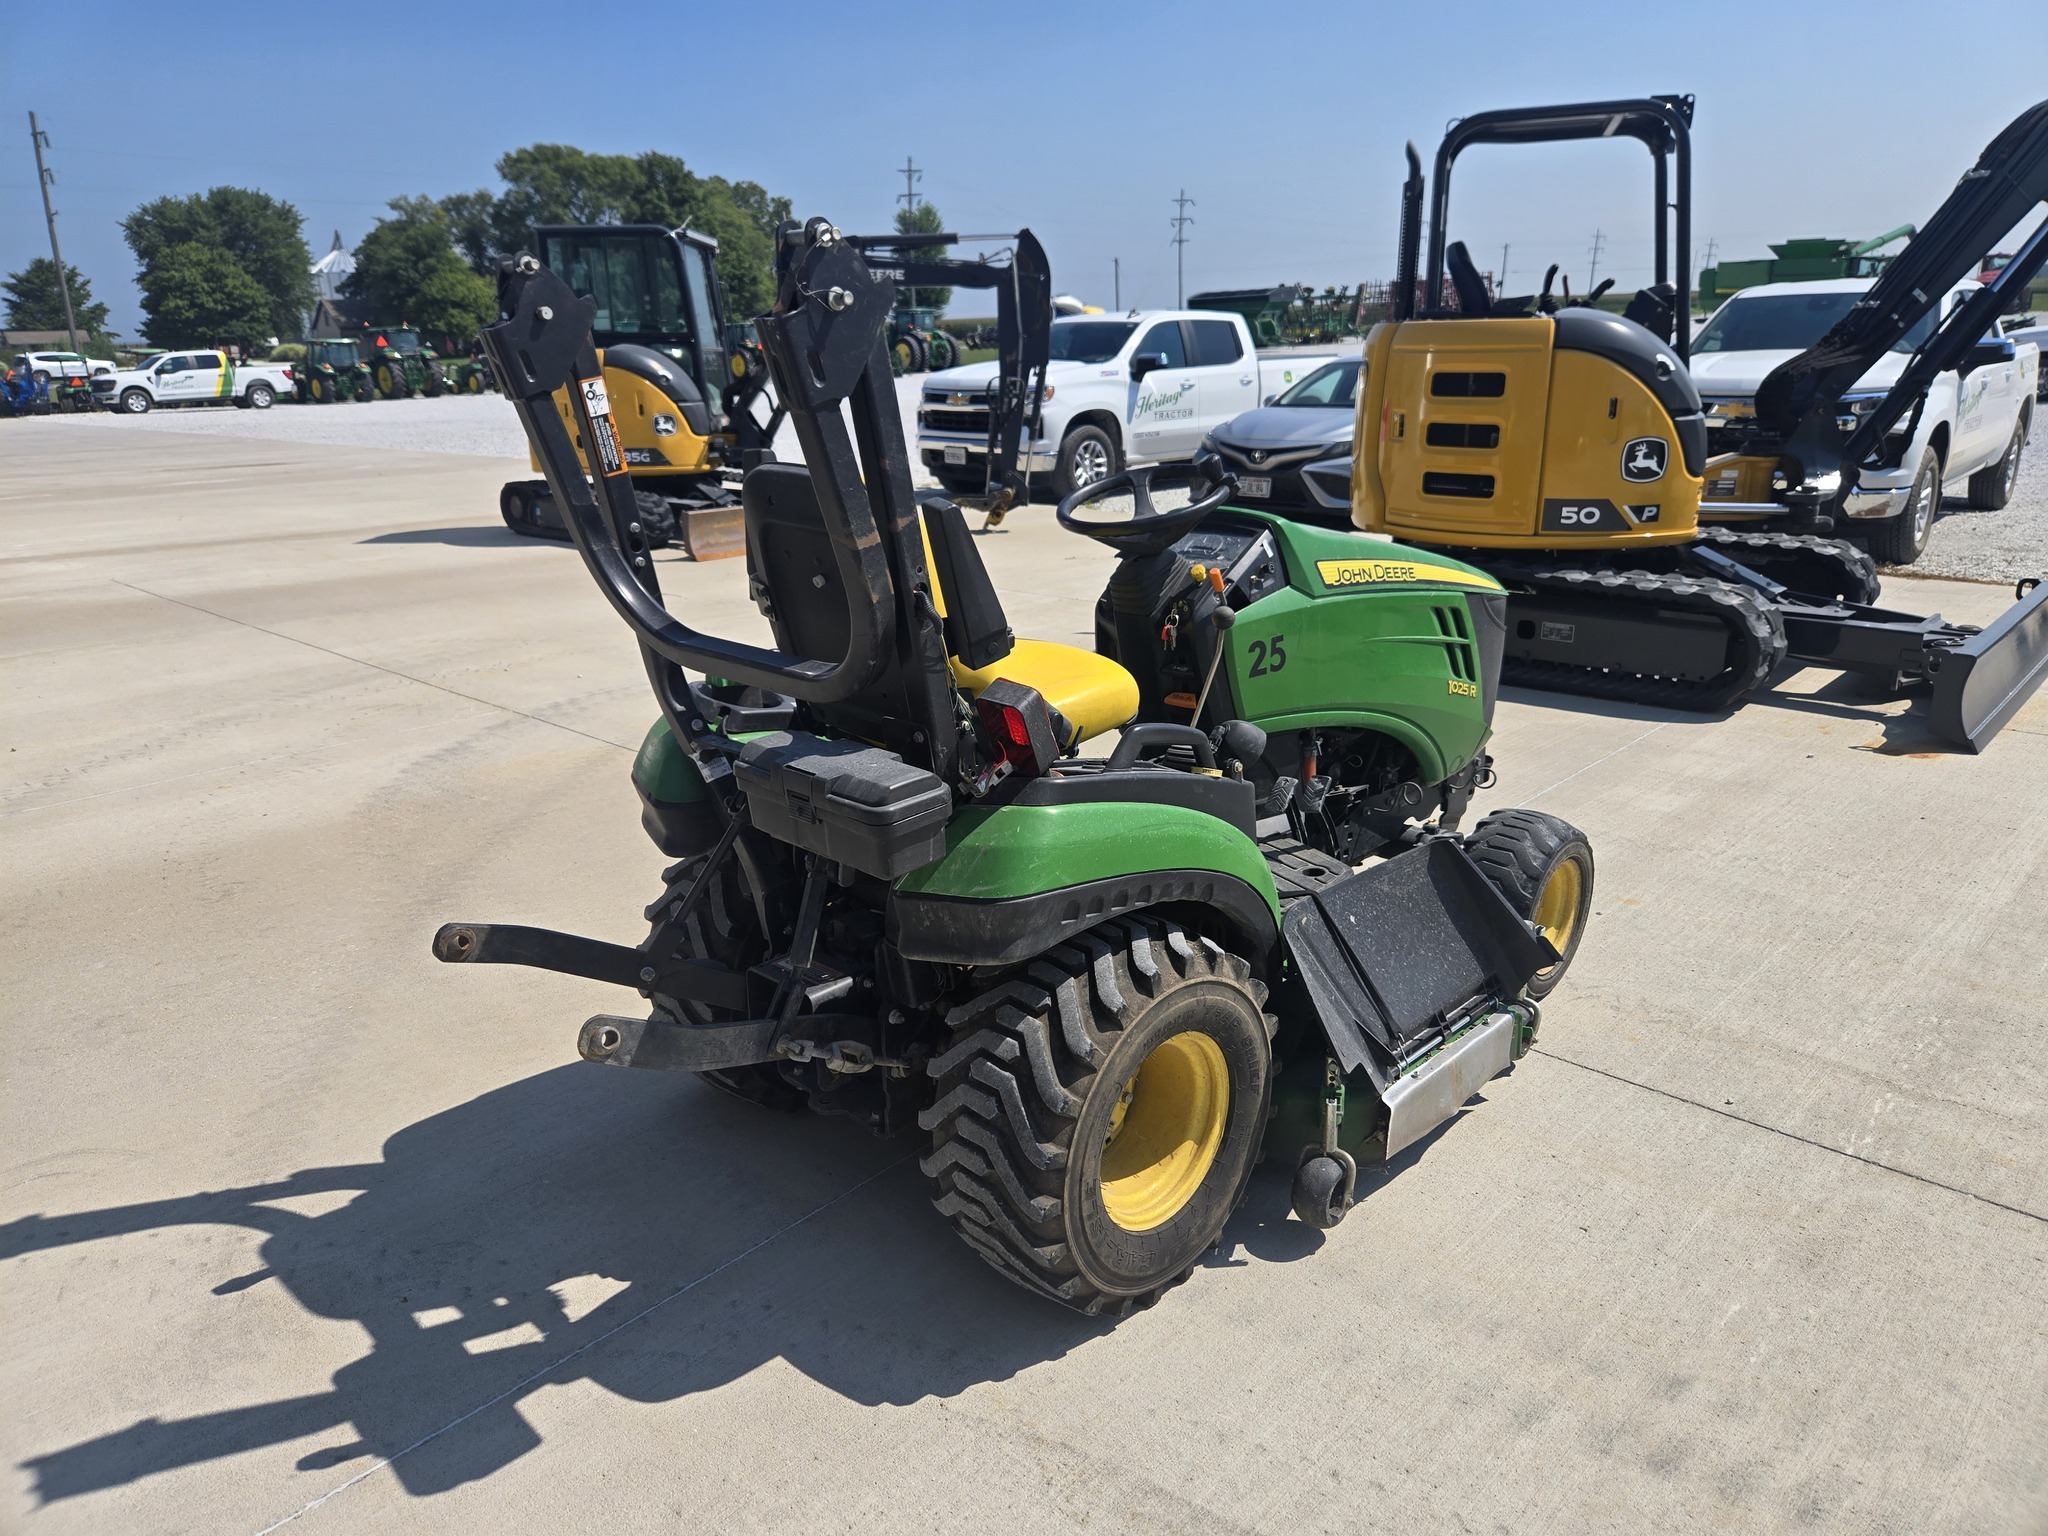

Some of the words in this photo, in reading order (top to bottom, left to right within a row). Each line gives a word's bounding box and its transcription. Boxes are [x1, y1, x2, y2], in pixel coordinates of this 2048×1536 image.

[868, 268, 905, 280] EERE
[1135, 389, 1185, 419] Heritage
[1153, 409, 1193, 420] TRACTOR
[613, 430, 625, 464] WARNING
[1560, 506, 1600, 524] 50
[1641, 506, 1658, 521] P
[1334, 567, 1373, 583] JOHN
[1373, 564, 1416, 580] DEERE
[1247, 634, 1287, 679] 25
